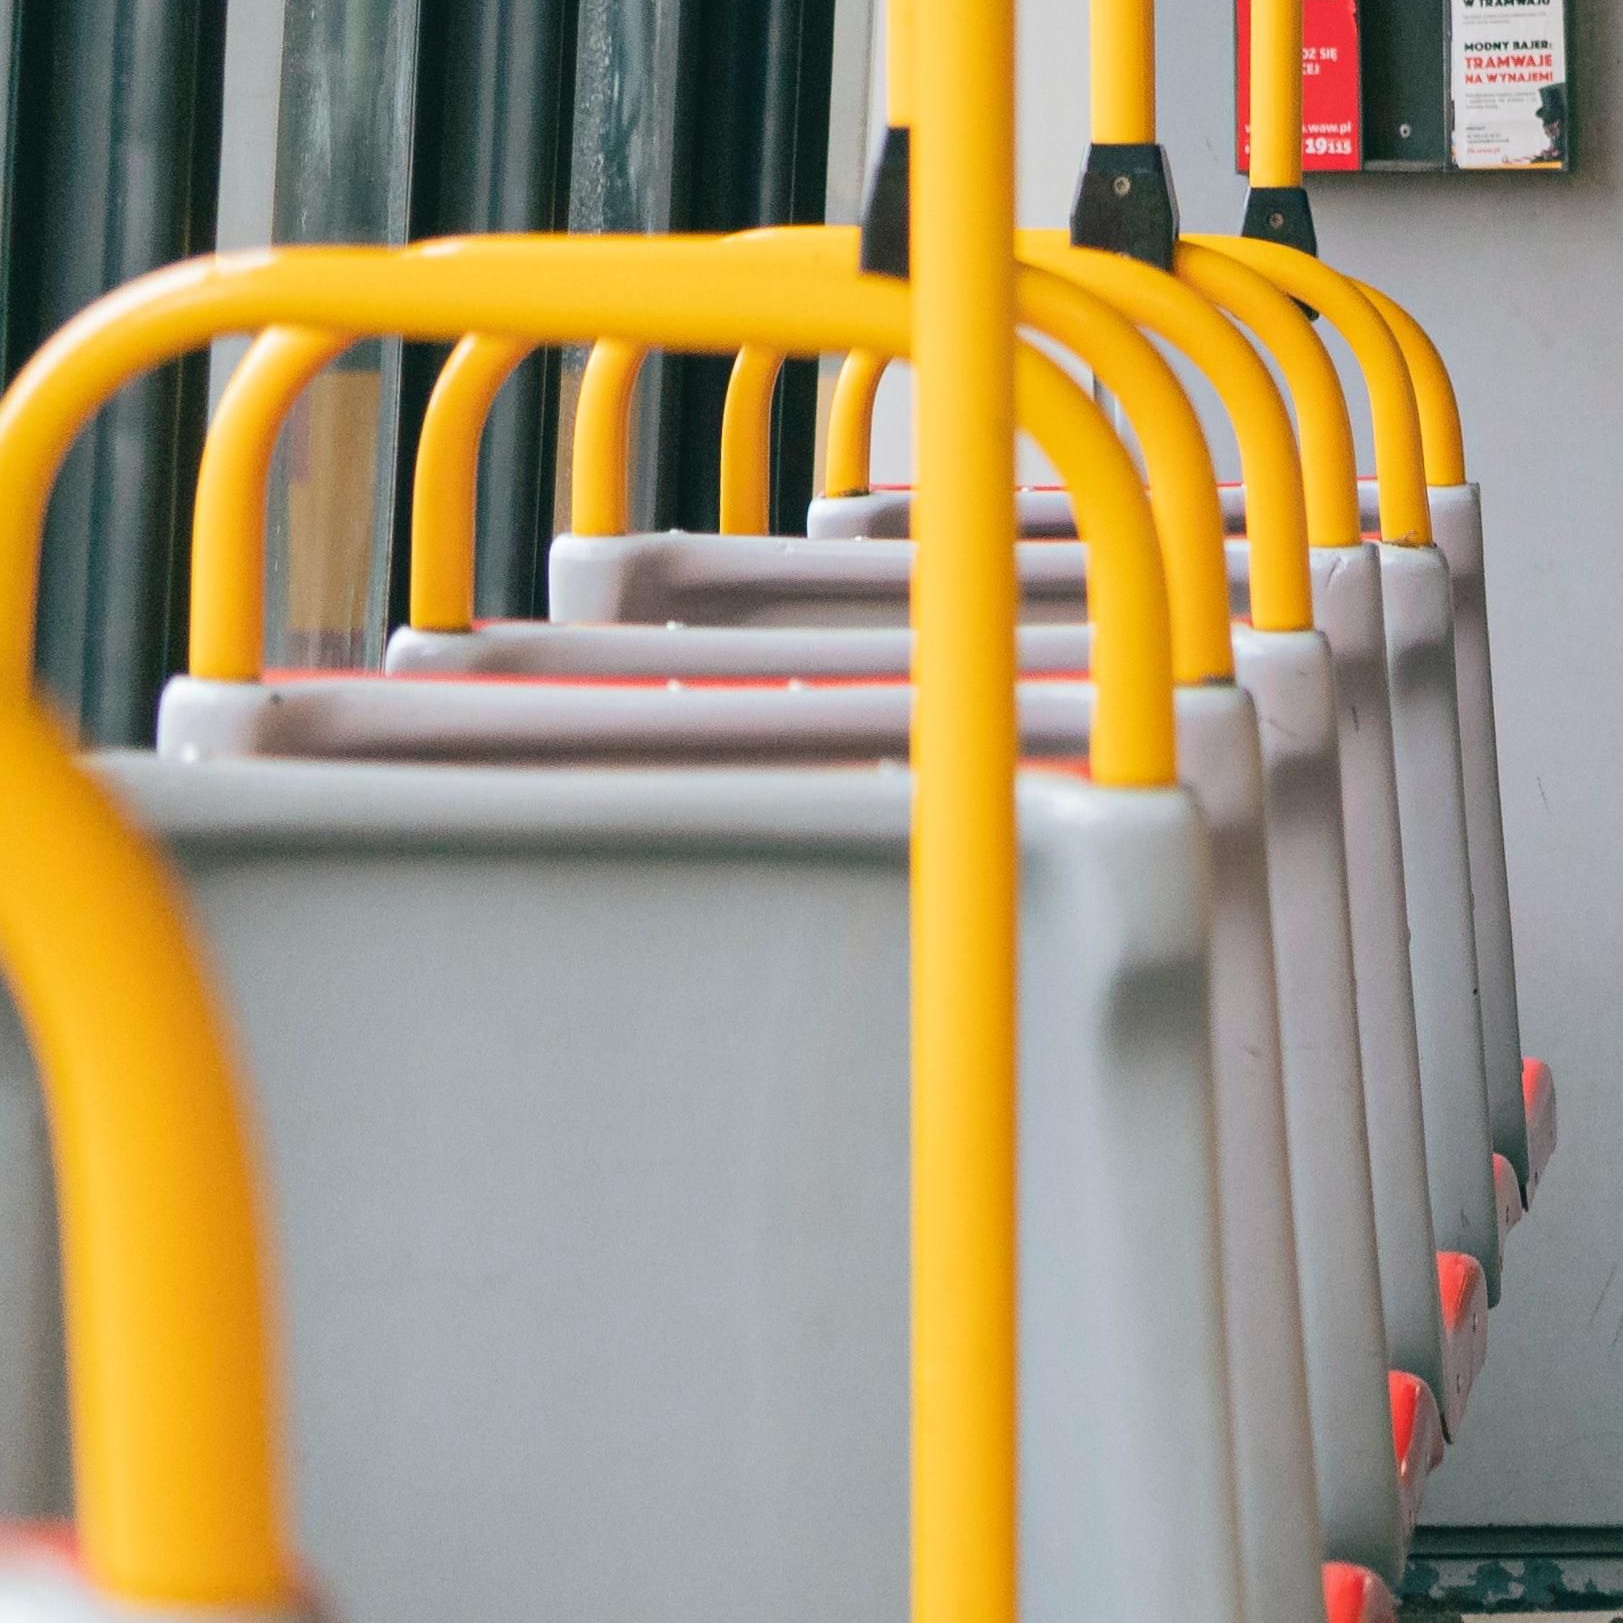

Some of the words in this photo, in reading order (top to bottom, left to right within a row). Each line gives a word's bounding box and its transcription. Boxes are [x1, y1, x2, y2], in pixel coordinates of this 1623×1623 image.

[1464, 41, 1509, 52] MODNY
[1465, 54, 1553, 70] TRAMWAJE
[1465, 75, 1483, 84] NA
